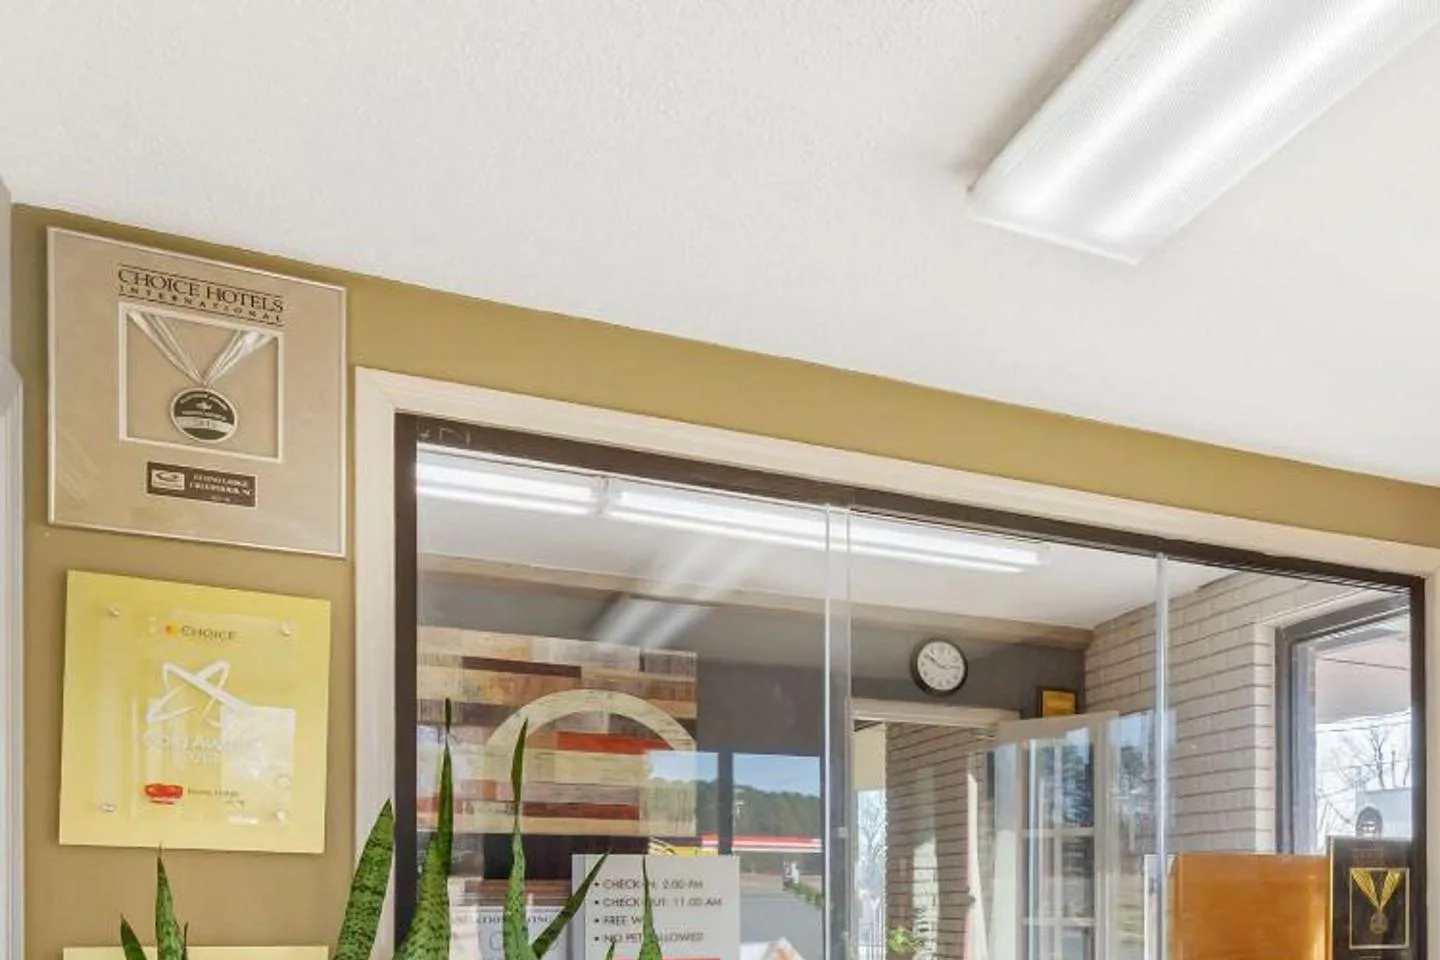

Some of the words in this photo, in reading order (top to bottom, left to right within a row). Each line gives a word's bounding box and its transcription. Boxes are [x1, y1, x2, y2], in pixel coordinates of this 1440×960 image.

[118, 268, 200, 297] CHOICE
[205, 285, 284, 314] HOTELS
[120, 284, 282, 322] INTERNATIONAL
[705, 896, 722, 906] AM
[603, 915, 628, 925] FREE
[659, 933, 704, 942] LLOWED
